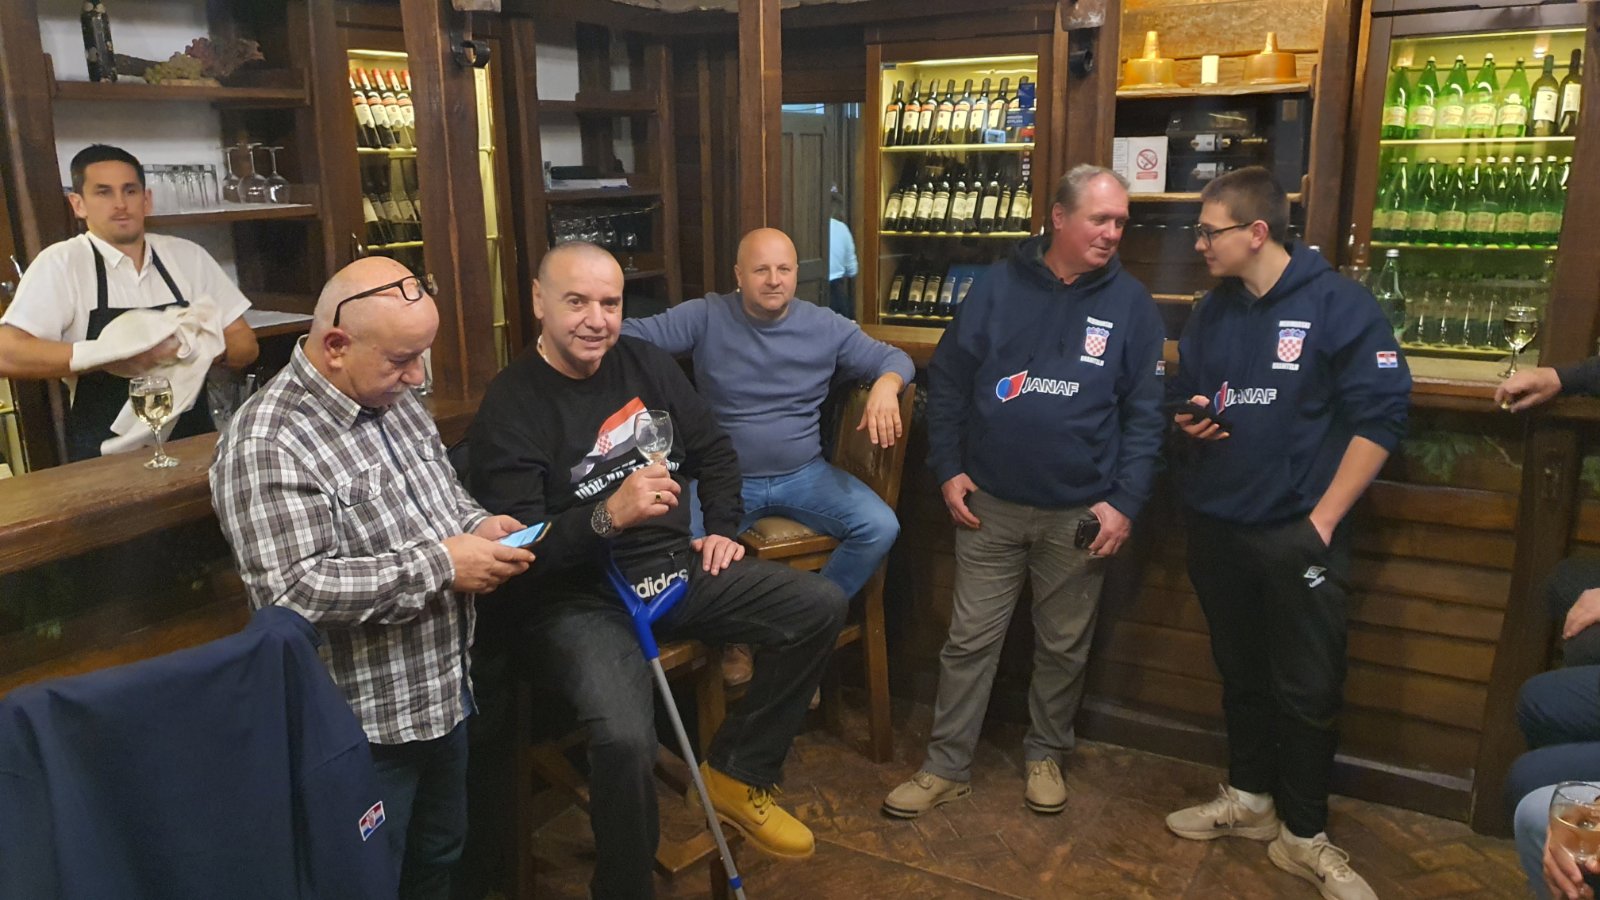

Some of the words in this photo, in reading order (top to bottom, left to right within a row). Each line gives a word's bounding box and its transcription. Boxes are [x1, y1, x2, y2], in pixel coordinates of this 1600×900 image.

[1022, 377, 1080, 397] JANAF
[1224, 388, 1277, 407] JANAF
[630, 568, 689, 598] dids
